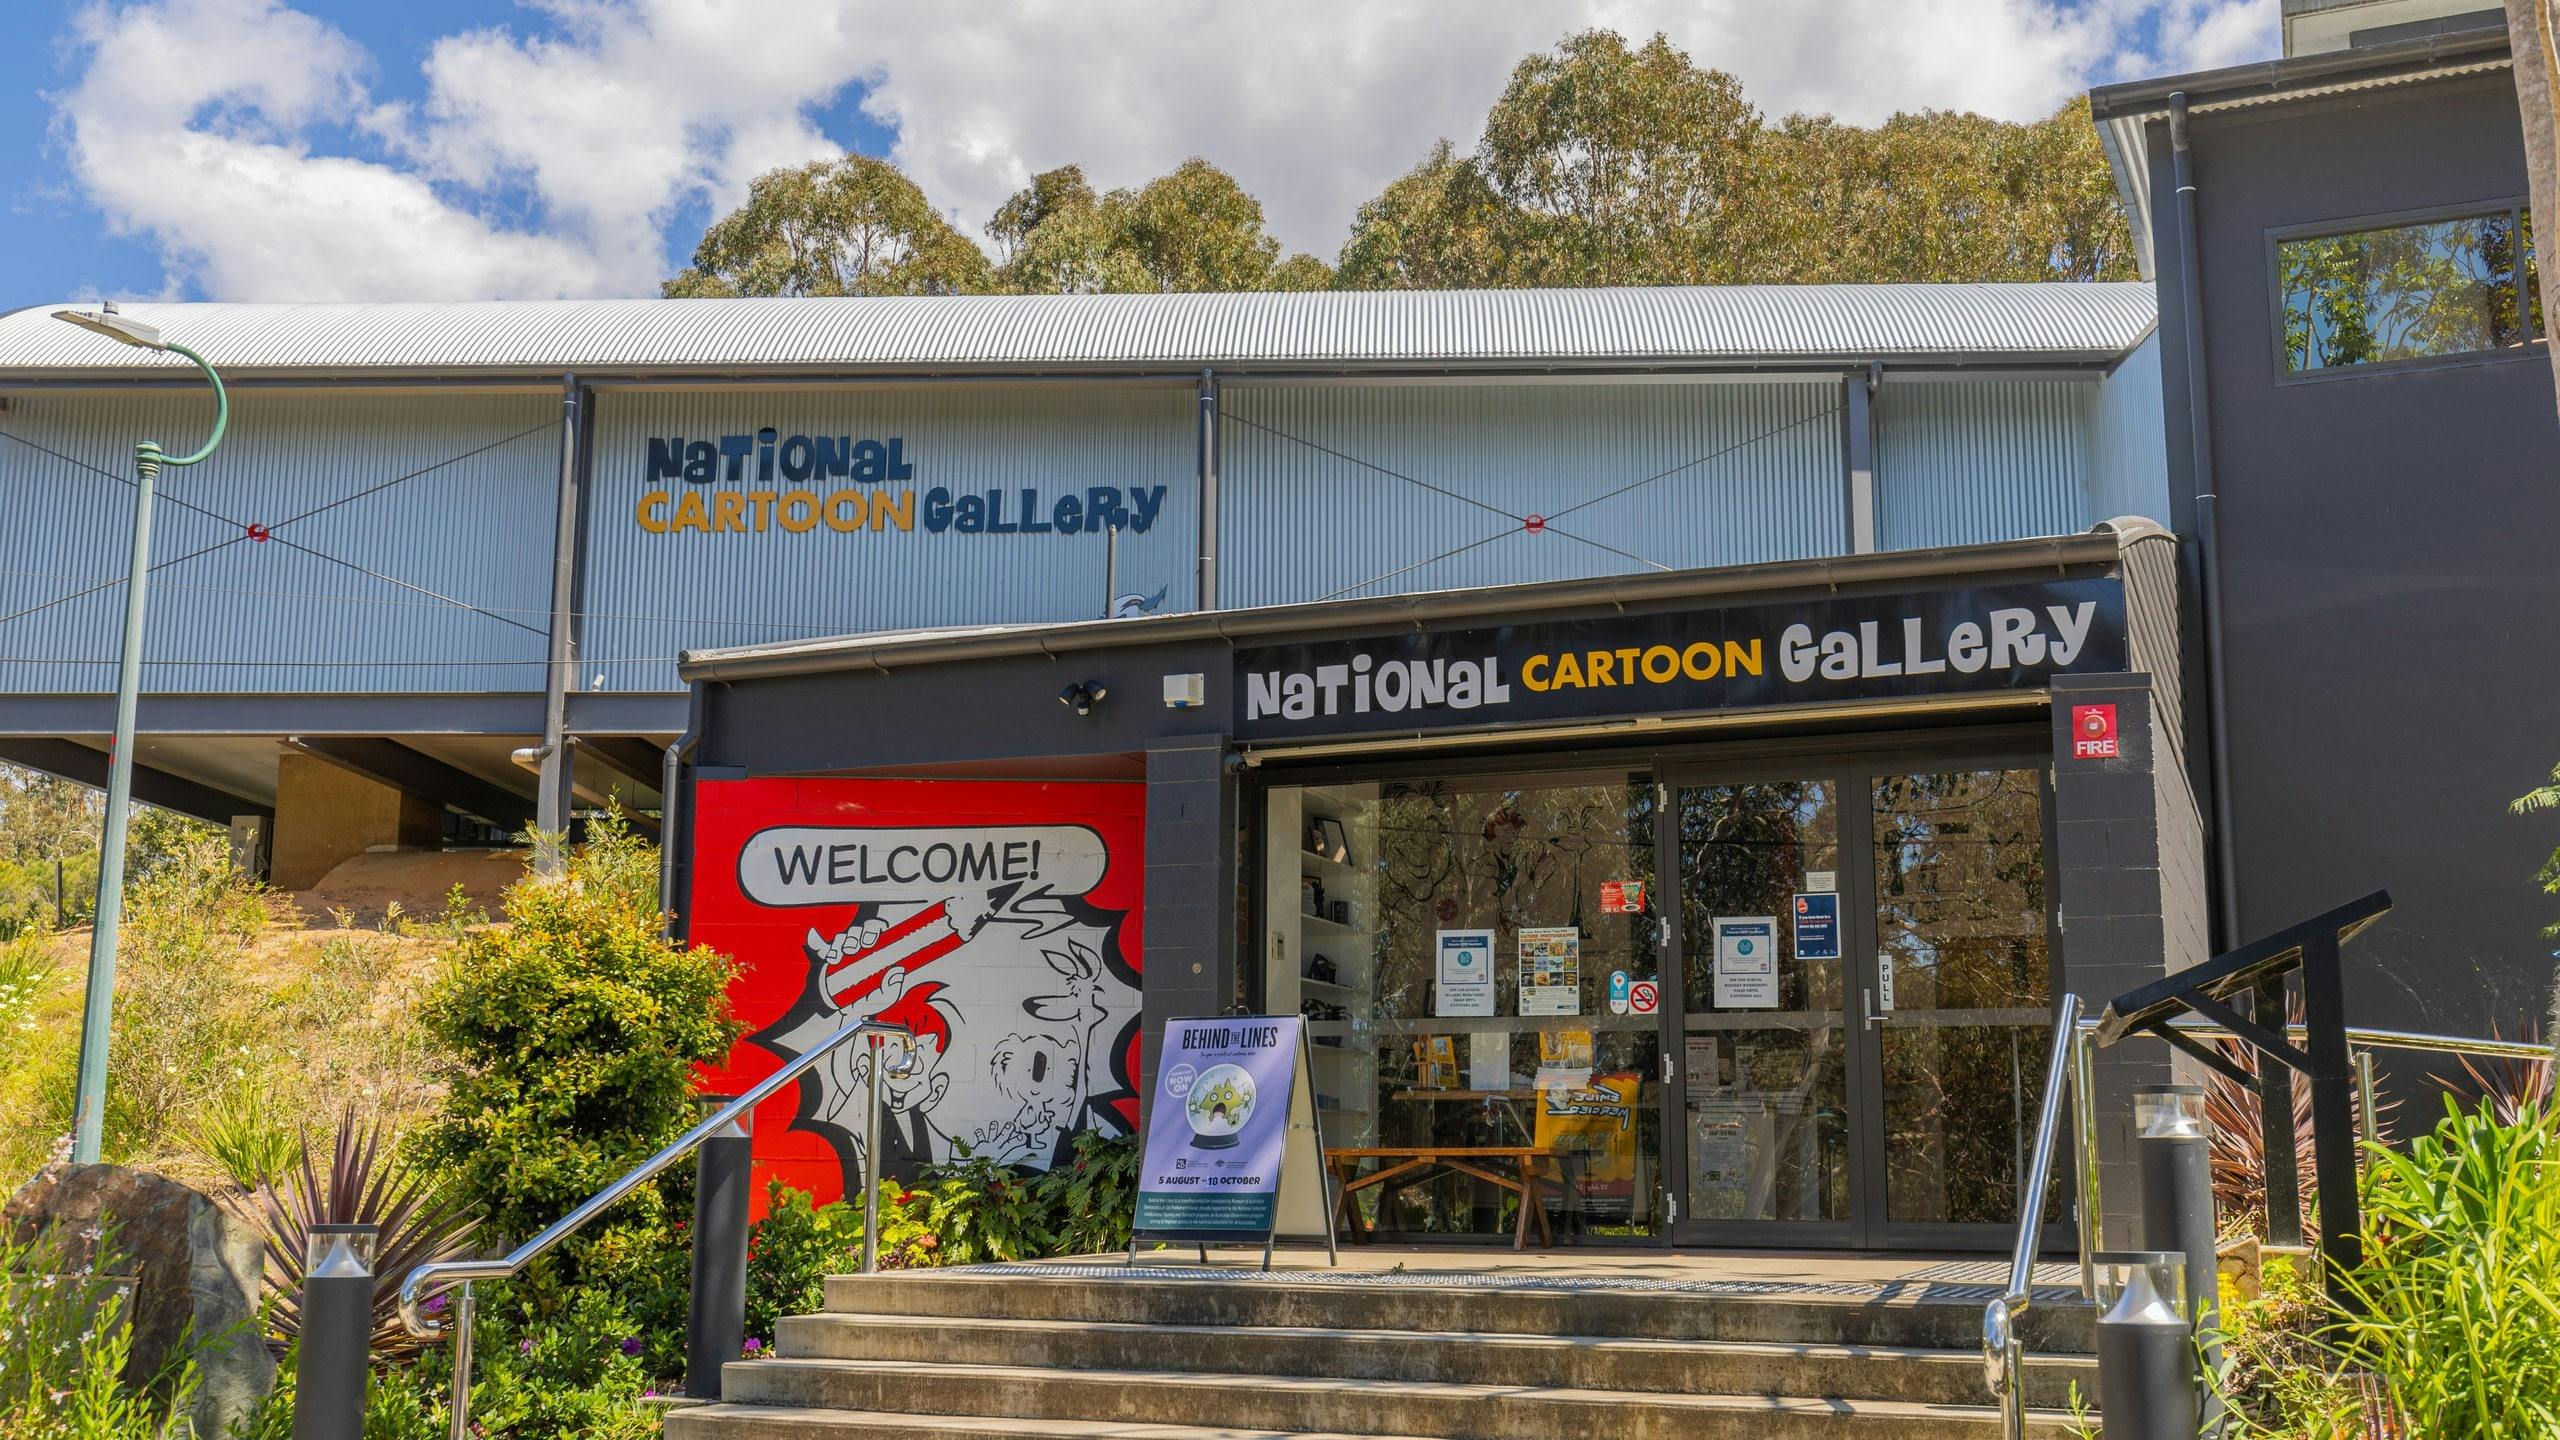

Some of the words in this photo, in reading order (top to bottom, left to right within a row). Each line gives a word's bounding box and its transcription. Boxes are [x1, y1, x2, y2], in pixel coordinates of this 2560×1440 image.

[637, 489, 915, 533] CARTOON
[1521, 638, 1763, 692] CARTOON
[2076, 740, 2115, 755] FIRE
[774, 839, 1041, 886] WELCOME!
[1882, 964, 1890, 1001] PULL
[1182, 1028, 1230, 1049] BEHIND
[1240, 1026, 1278, 1049] LINES
[1169, 1075, 1193, 1085] NOW
[1174, 1083, 1188, 1092] ON
[1158, 1176, 1164, 1184] 5
[1166, 1176, 1200, 1185] AUGUST
[1208, 1177, 1218, 1186] 18
